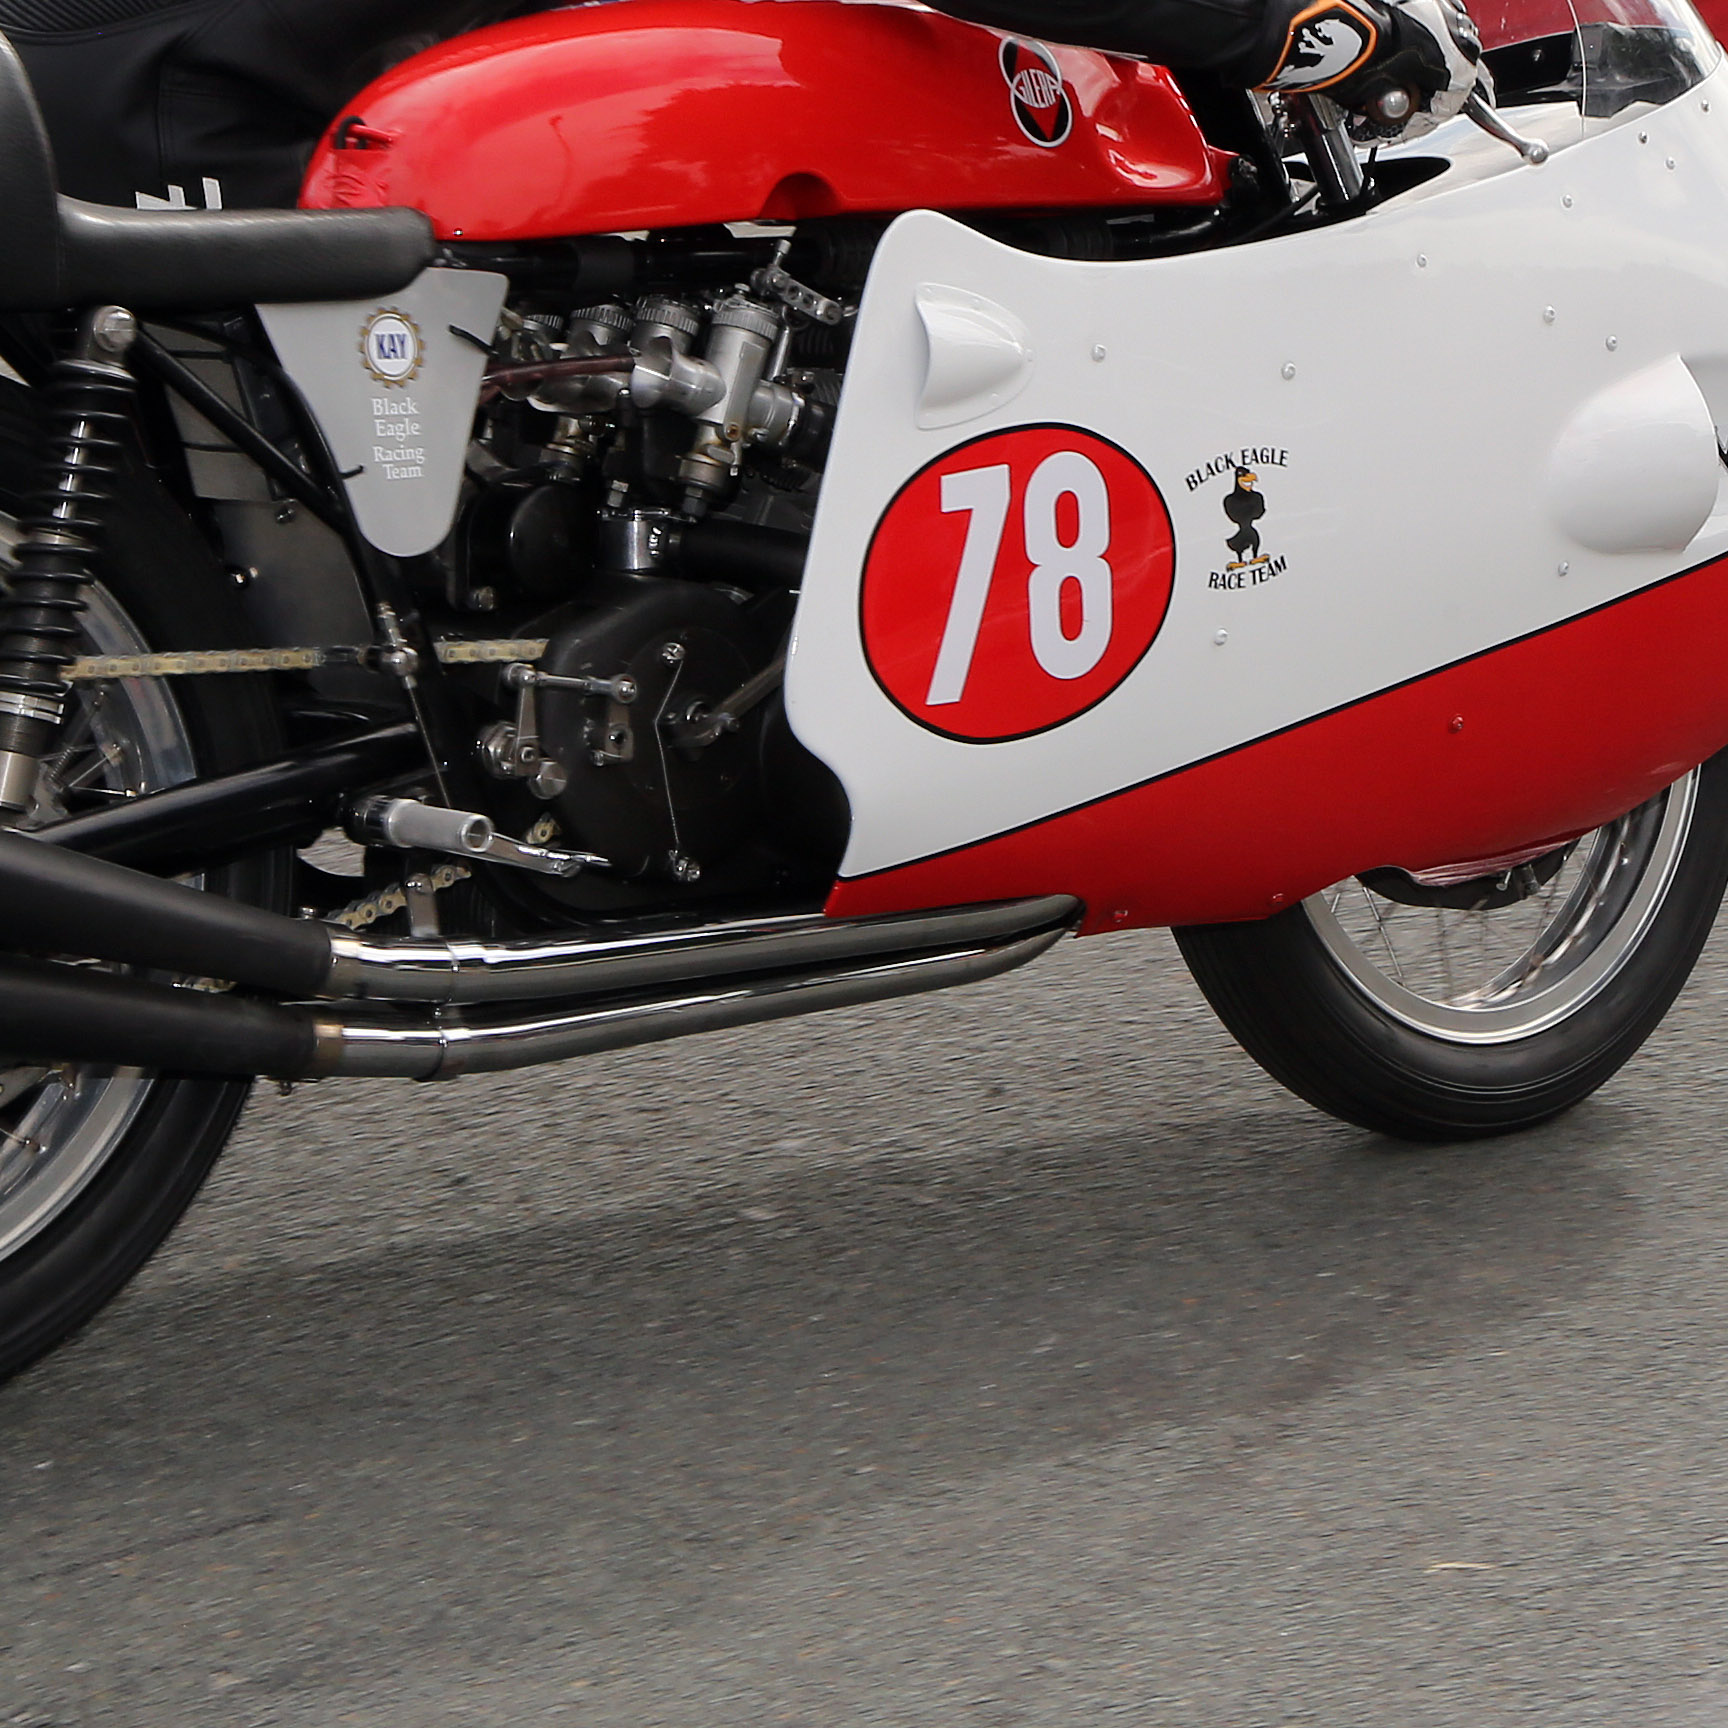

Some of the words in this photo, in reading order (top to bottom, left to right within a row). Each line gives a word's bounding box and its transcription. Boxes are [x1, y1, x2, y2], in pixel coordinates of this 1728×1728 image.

[1012, 68, 1061, 108] GILERA
[375, 333, 408, 360] KAY
[371, 397, 419, 416] Black
[374, 418, 421, 441] Eagle
[373, 445, 425, 464] Racing
[383, 463, 424, 480] Team
[1185, 451, 1237, 492] BLACK
[1240, 447, 1288, 468] EAGLE
[925, 450, 1113, 705] 78
[1208, 572, 1247, 590] RACE
[1249, 555, 1287, 585] TEAM
